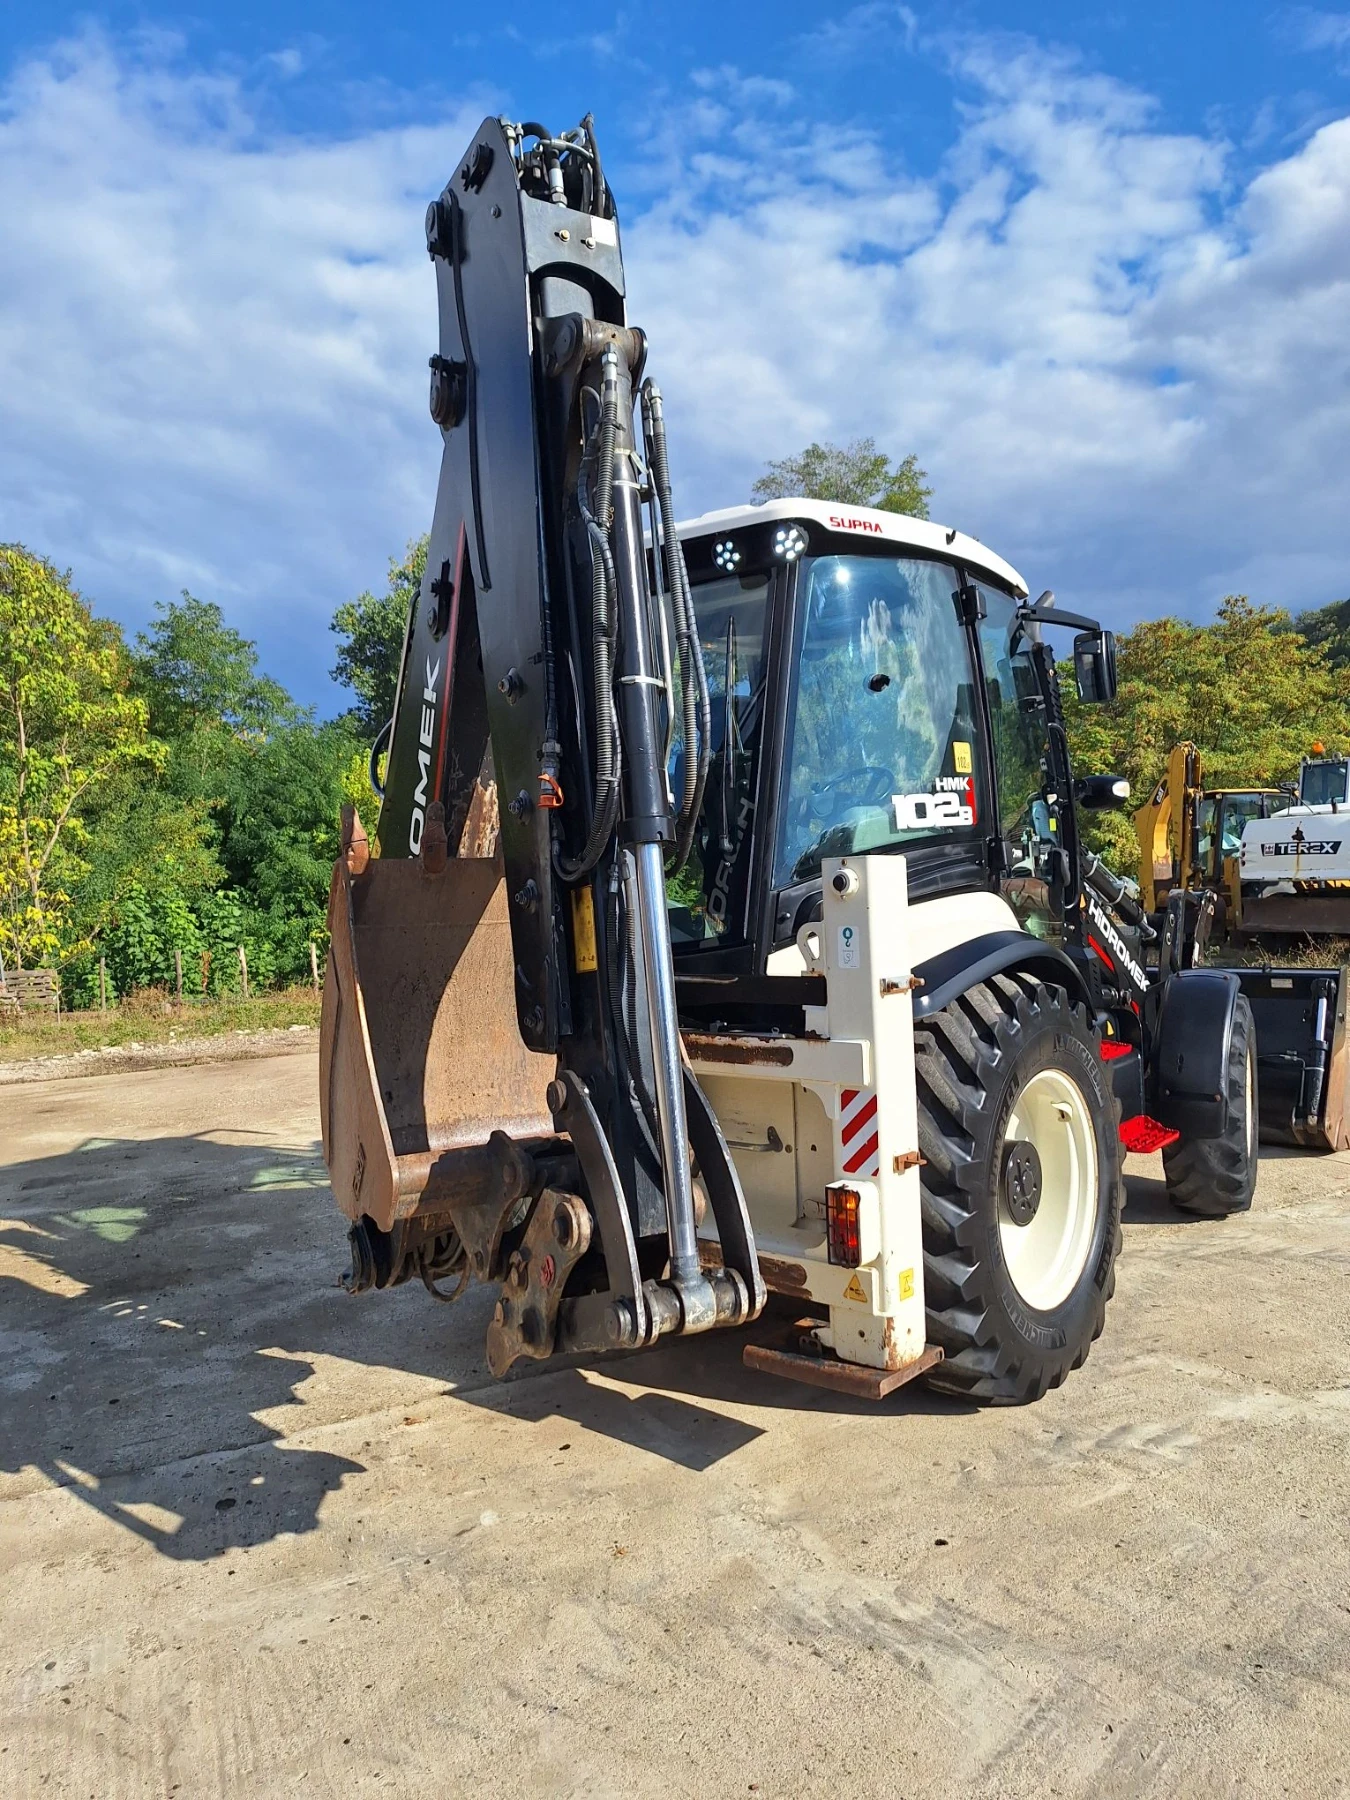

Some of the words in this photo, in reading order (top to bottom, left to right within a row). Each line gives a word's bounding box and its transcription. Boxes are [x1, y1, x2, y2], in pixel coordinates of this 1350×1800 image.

[829, 516, 883, 533] SUPRA
[408, 654, 441, 859] OMEK
[935, 776, 971, 791] HMK
[1278, 842, 1336, 854] TEREX
[1088, 898, 1151, 992] HIDROMEK
